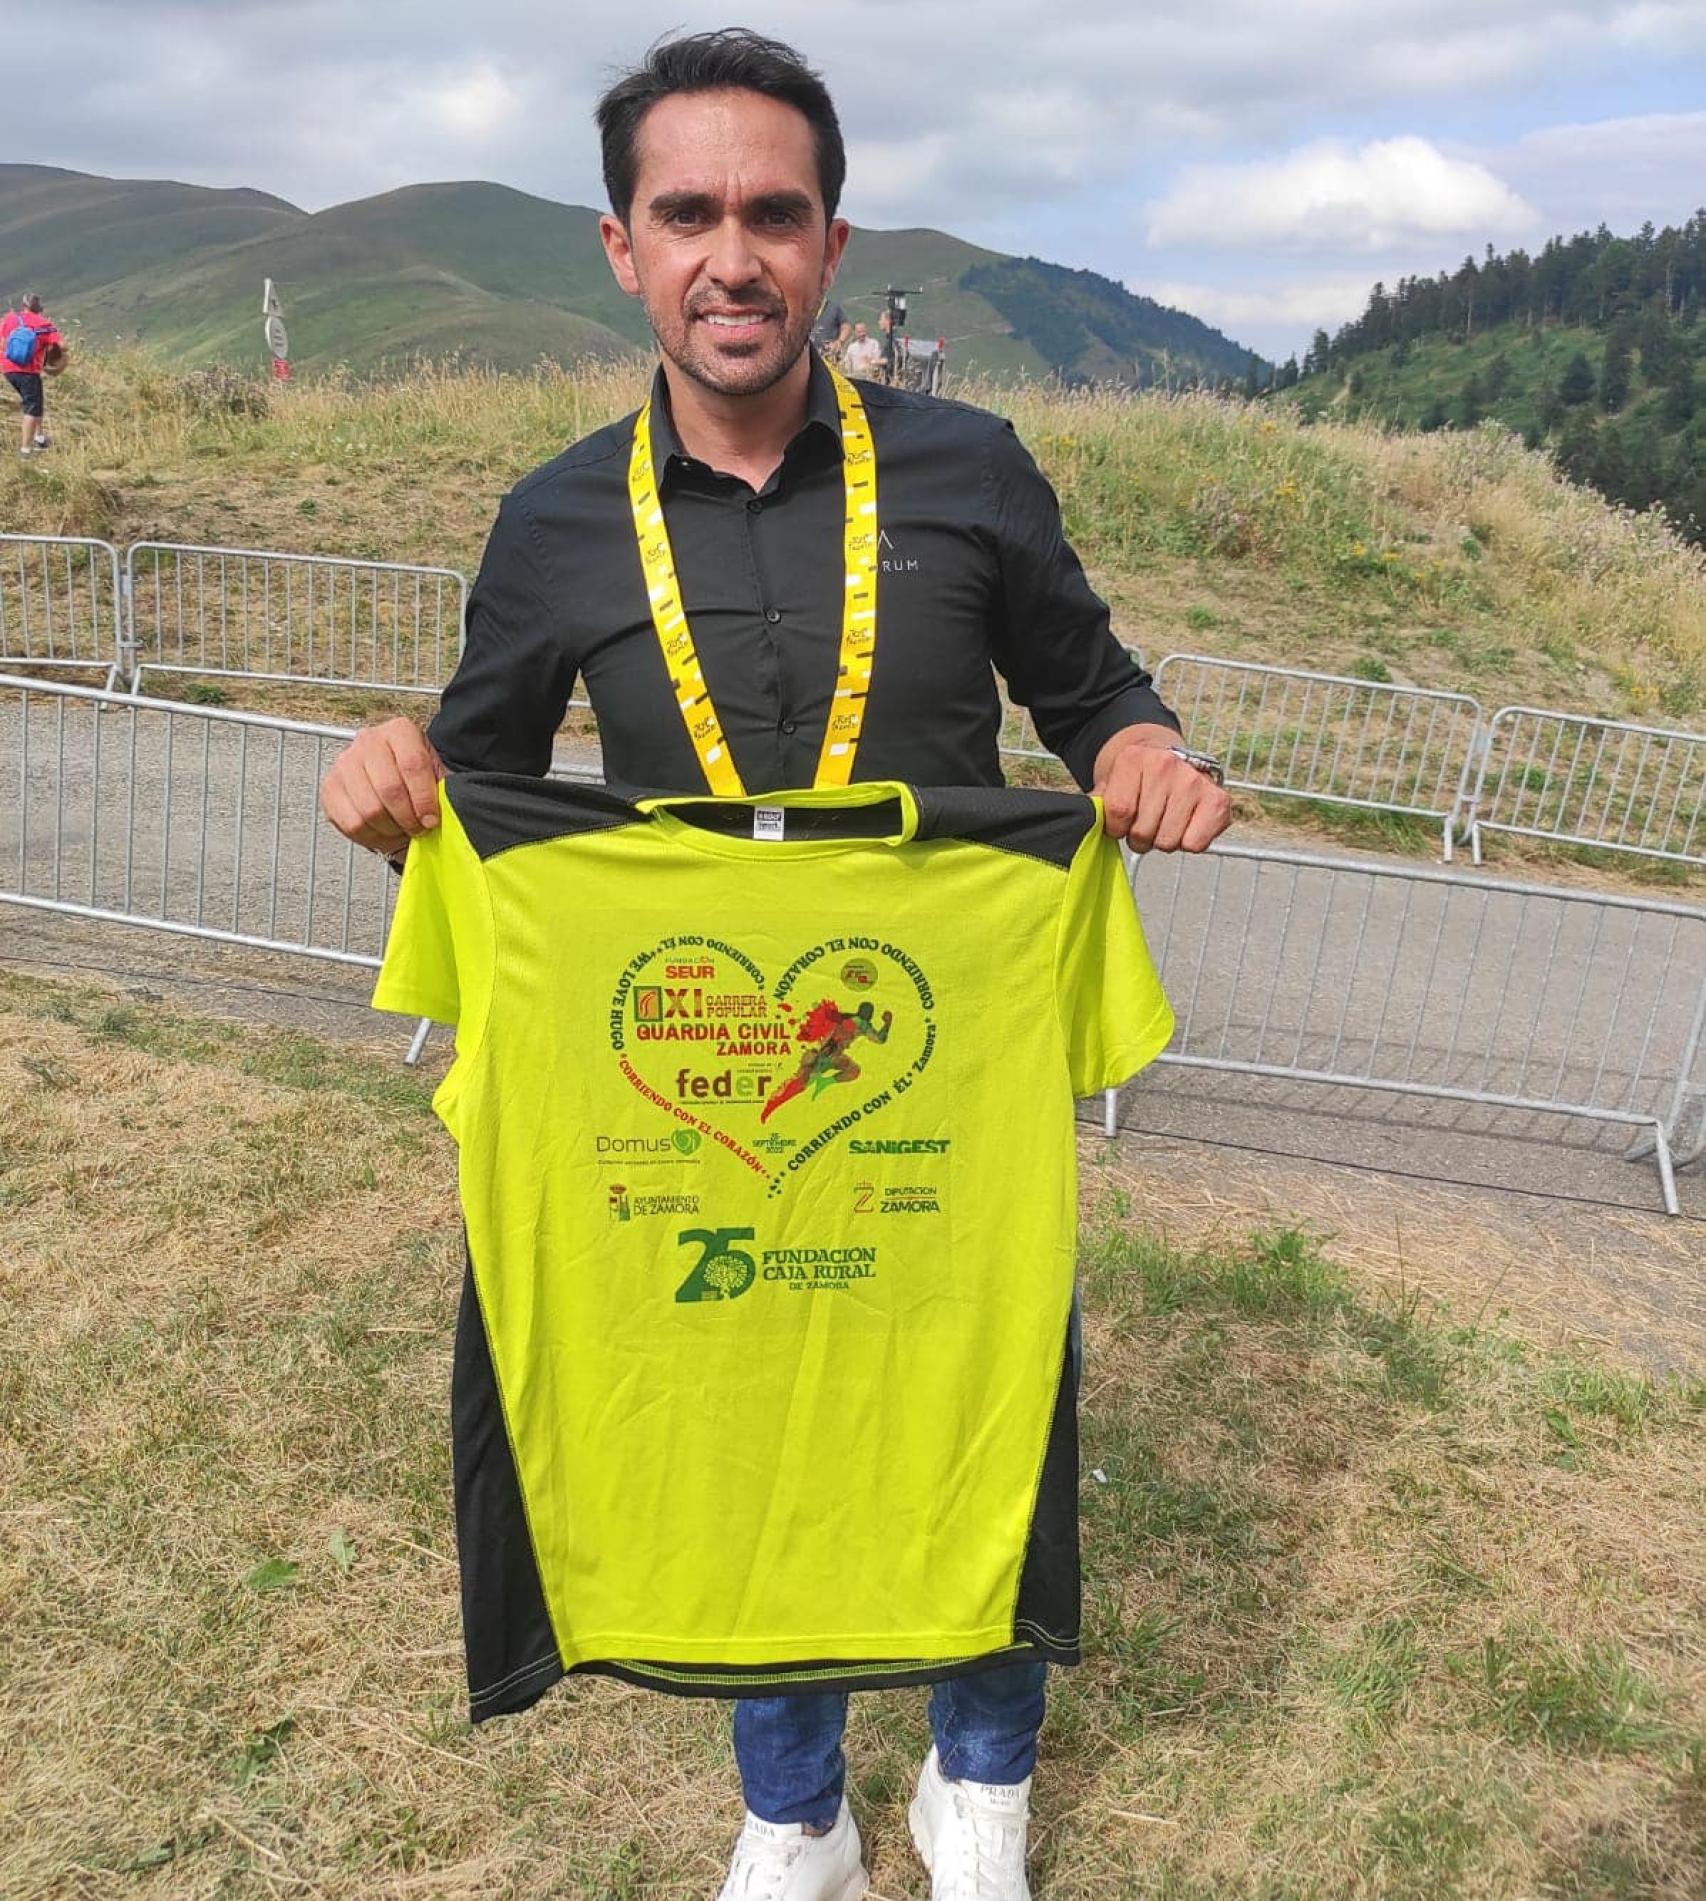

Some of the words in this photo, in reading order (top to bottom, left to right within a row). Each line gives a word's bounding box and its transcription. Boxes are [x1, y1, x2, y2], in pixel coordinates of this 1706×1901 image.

[883, 559, 919, 573] RUM
[679, 936, 704, 946] CON
[825, 939, 845, 952] EL
[848, 937, 879, 951] CON
[706, 938, 765, 984] CORRIENDO
[665, 965, 715, 979] SEUR
[881, 943, 935, 1010] CORRIENDO
[612, 970, 636, 1007] LOVE
[664, 988, 703, 1018] XI
[706, 995, 767, 1006] CARRERA
[706, 1006, 767, 1018] POPULAR
[610, 1009, 624, 1050] HUGO
[636, 1022, 730, 1041] GUARDIA
[737, 1022, 791, 1040] CIVIL
[716, 1041, 791, 1056] ZAMORA
[912, 1024, 936, 1073] Zamora
[676, 1068, 772, 1098] feder
[619, 1059, 672, 1111] CORRIENDO
[674, 1108, 698, 1126] CON
[698, 1121, 712, 1135] EL
[787, 1110, 862, 1171] CORRIENDO
[863, 1090, 892, 1115] CON
[633, 1204, 648, 1215] DE
[649, 1203, 700, 1214] ZAMORA
[880, 1200, 940, 1213] ZAMORA
[675, 1227, 756, 1303] 25
[763, 1265, 809, 1281] CAJA
[813, 1263, 876, 1279] RURAL
[789, 1282, 803, 1291] DE
